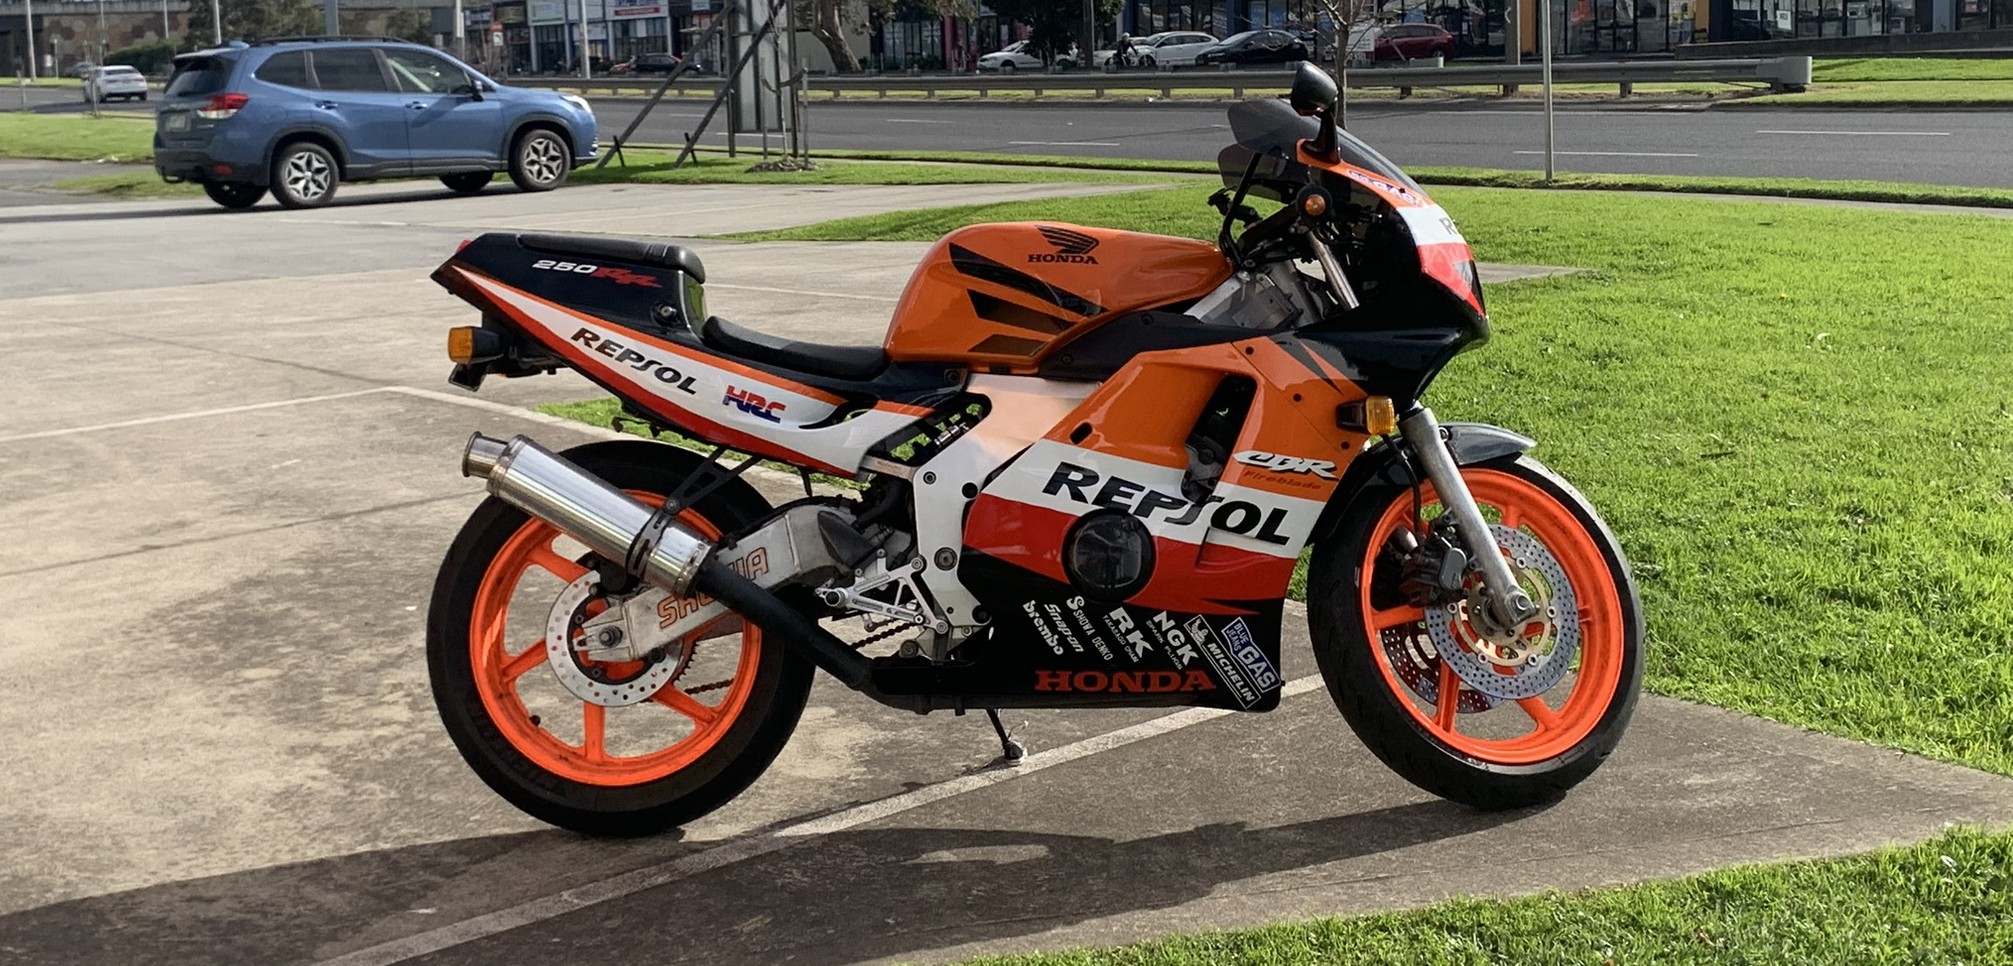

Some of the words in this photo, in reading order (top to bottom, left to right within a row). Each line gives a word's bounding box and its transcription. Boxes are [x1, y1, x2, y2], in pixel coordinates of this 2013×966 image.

[1027, 253, 1099, 265] HONDA
[570, 327, 697, 395] REPSOL
[722, 385, 786, 424] HRC
[1233, 450, 1340, 480] CBR
[1242, 470, 1322, 490] Fireblade
[1042, 461, 1291, 546] REPSOL
[1022, 600, 1064, 655] brembo
[1073, 610, 1096, 636] SHOWA
[1091, 636, 1114, 661] DENKO
[1109, 606, 1154, 658] RK
[1145, 619, 1165, 645] SPARK
[1164, 645, 1184, 671] PLUGS
[1152, 610, 1199, 666] NGK
[1226, 629, 1242, 653] JEANS
[1233, 622, 1250, 646] BLUE
[1123, 645, 1140, 663] CHAIN
[1206, 642, 1256, 702] MICHELIN
[1237, 645, 1277, 690] GAS
[1034, 670, 1217, 693] HONDA
